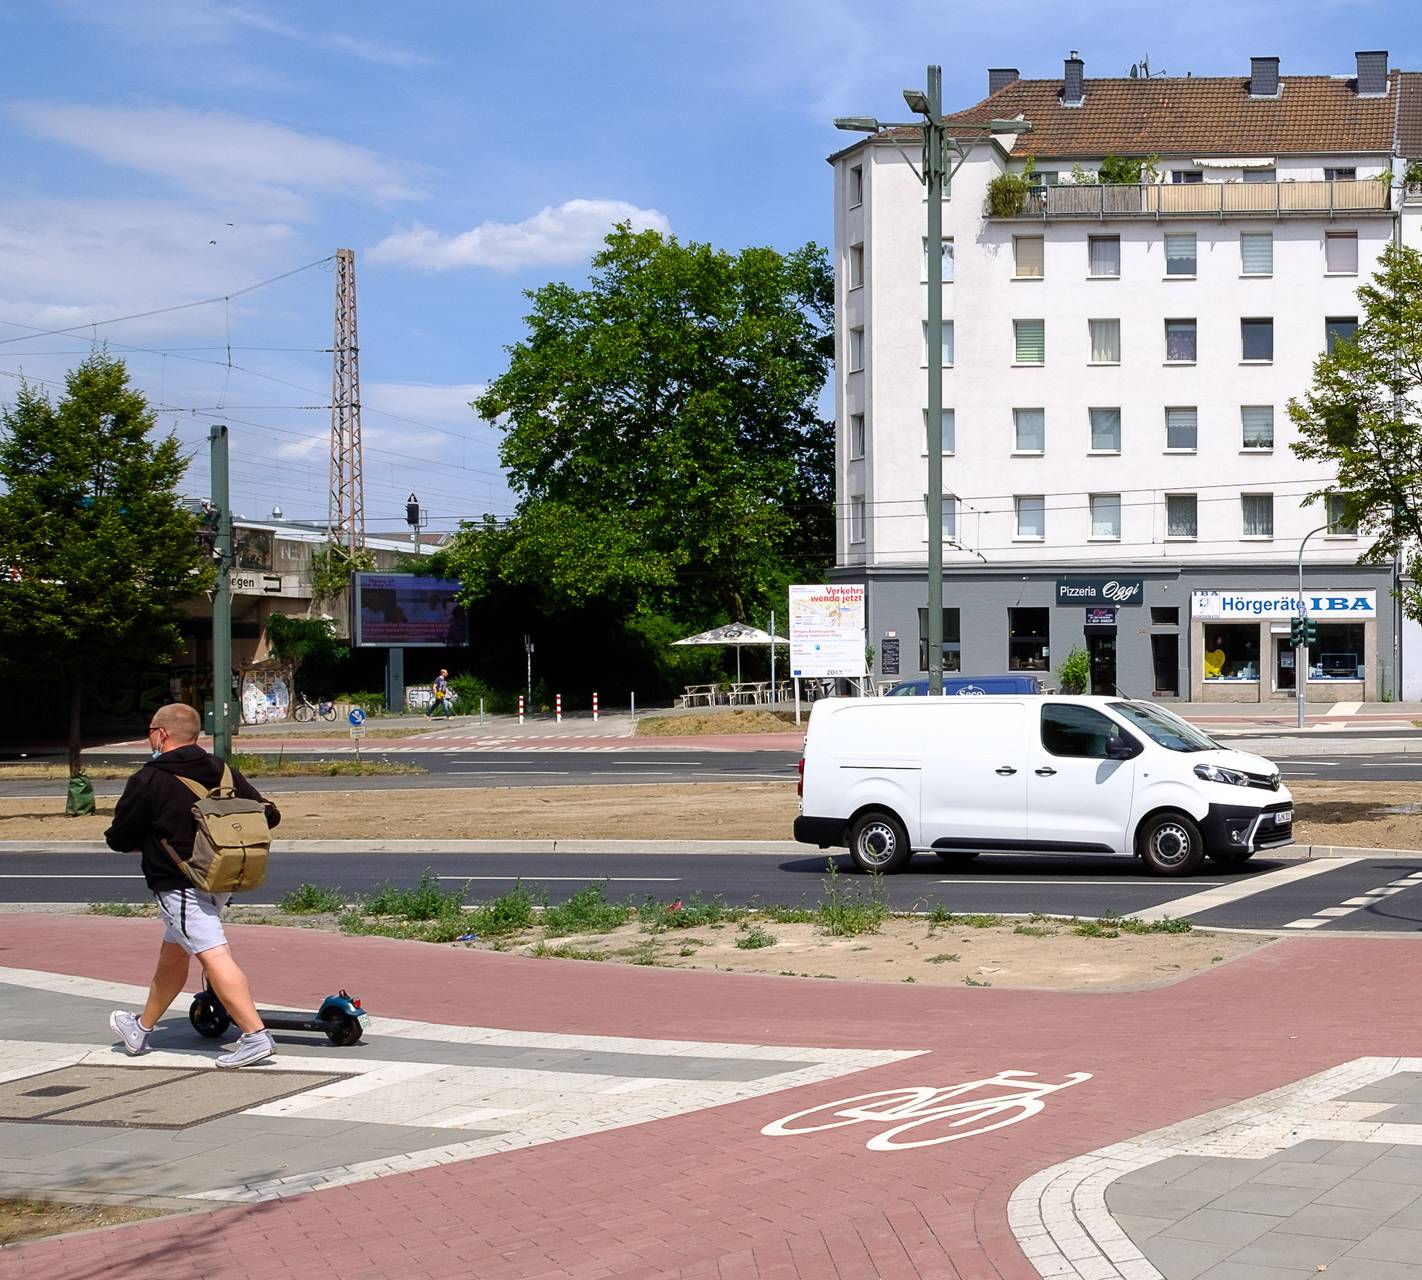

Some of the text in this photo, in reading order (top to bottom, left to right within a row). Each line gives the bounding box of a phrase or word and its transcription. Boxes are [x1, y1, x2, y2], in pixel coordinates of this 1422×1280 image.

[231, 578, 255, 589] egen
[825, 586, 864, 595] Verkehrs
[1060, 581, 1139, 601] Pizzeria Oggi
[810, 593, 862, 603] wende jetzt
[1222, 597, 1374, 614] Hörgeräte IBA
